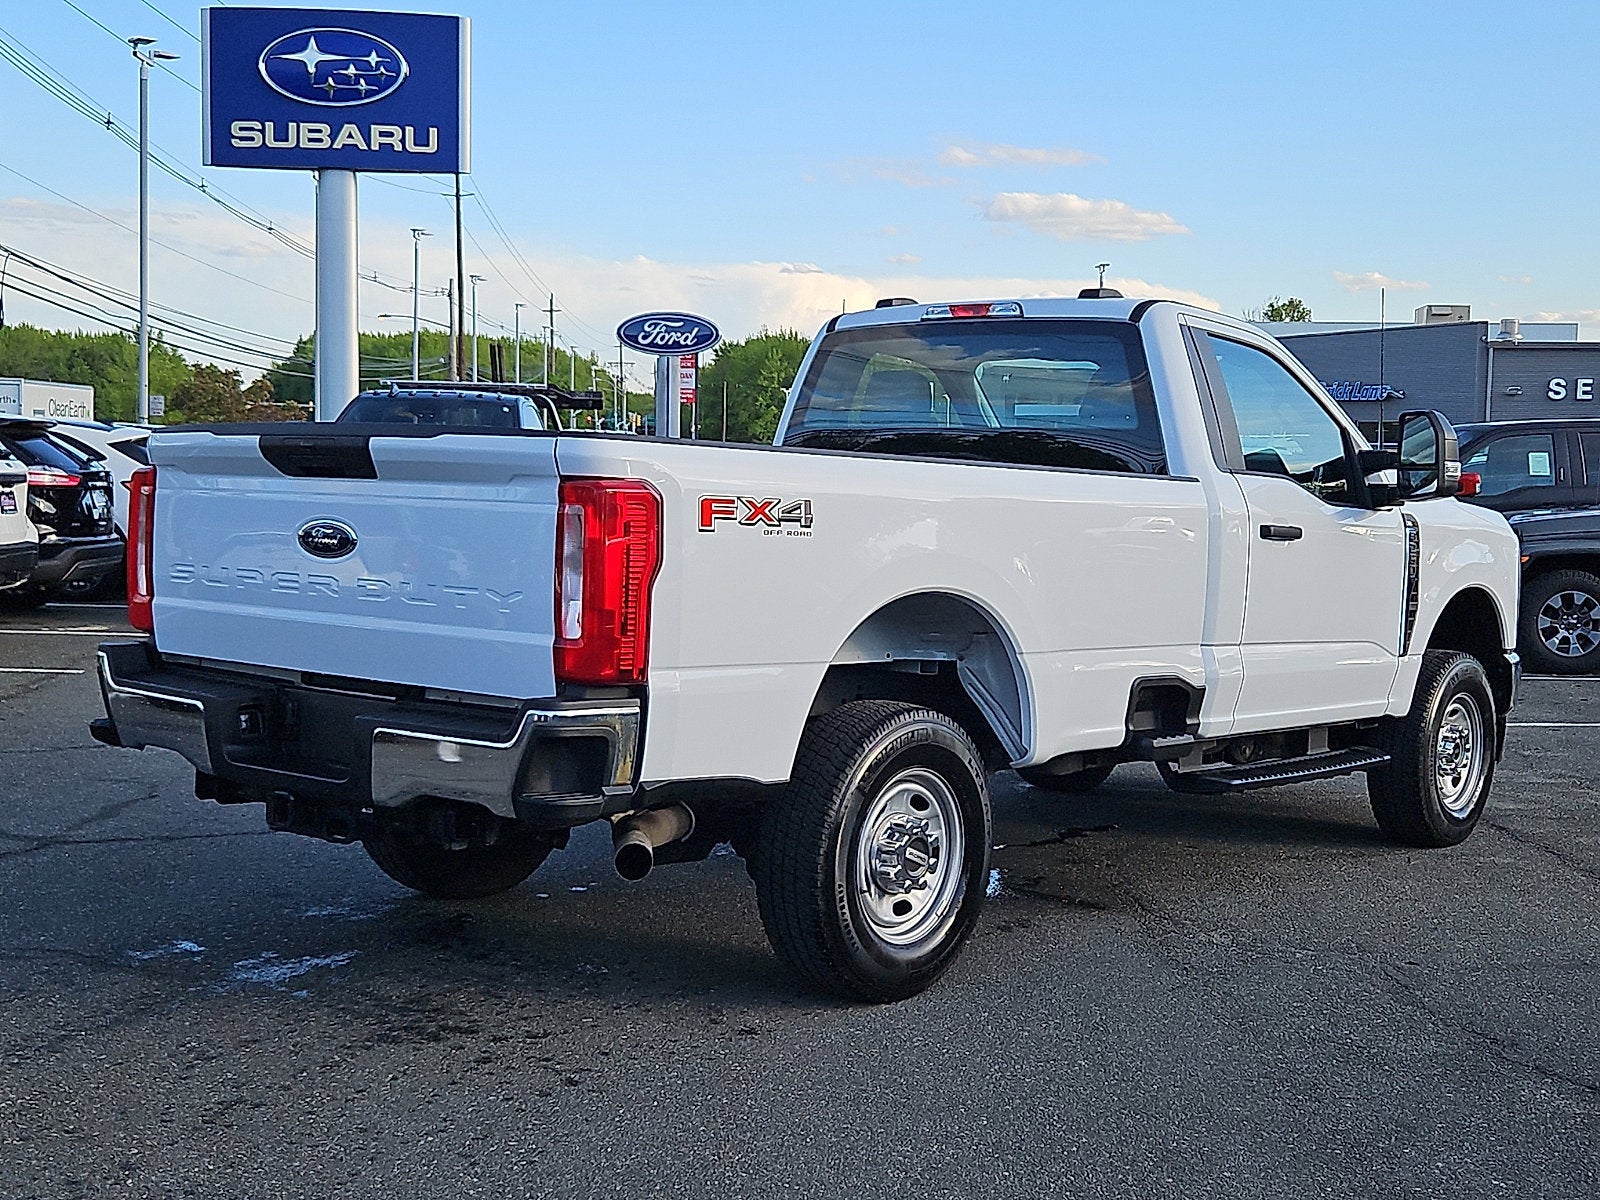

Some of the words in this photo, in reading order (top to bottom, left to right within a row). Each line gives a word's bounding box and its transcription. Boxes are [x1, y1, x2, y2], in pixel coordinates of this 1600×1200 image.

[230, 120, 438, 154] SUBARU
[637, 320, 700, 346] Ford
[1351, 381, 1389, 401] Lane
[1547, 378, 1594, 400] SE
[698, 495, 813, 532] FX4
[306, 526, 341, 549] Ford
[786, 529, 812, 537] ROAD
[169, 562, 340, 598] SUPER
[355, 577, 524, 612] DUTY
